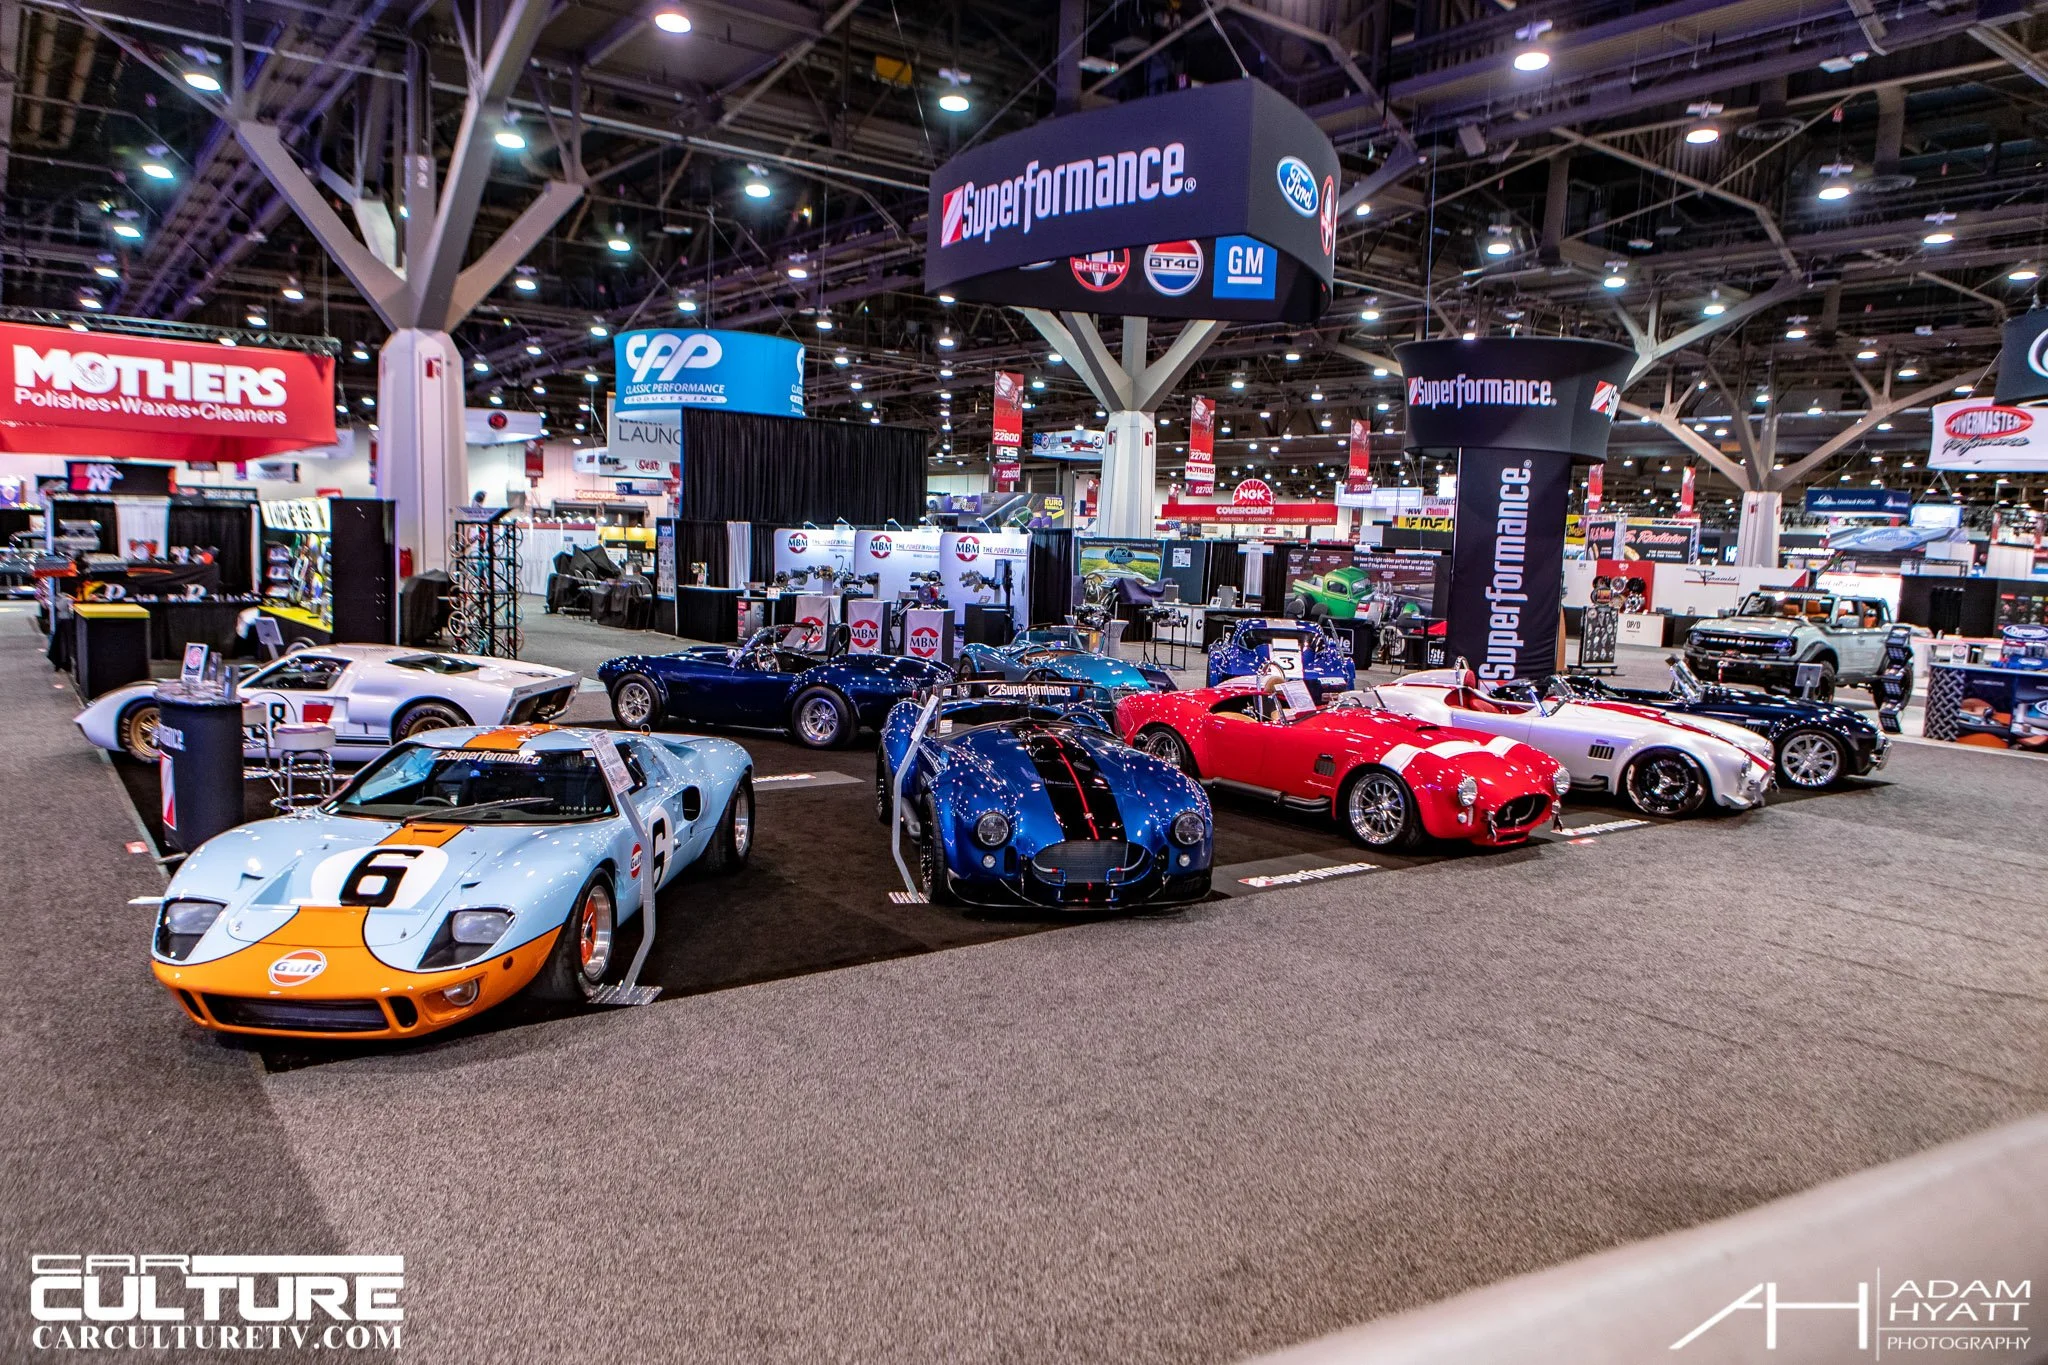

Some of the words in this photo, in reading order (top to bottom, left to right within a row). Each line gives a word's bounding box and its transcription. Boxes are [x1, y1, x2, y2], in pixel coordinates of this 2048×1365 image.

[1285, 163, 1314, 210] Ford
[1149, 257, 1200, 270] GT40
[1228, 245, 1264, 275] GM
[1074, 260, 1127, 274] SHELBY
[12, 344, 288, 408] MOTHERS
[625, 383, 652, 395] CLASSIC
[651, 383, 725, 394] PERFORMANCE
[1951, 410, 2021, 435] POWERMASTER
[994, 431, 1020, 443] 22600
[1190, 452, 1211, 462] 22700
[1186, 465, 1215, 475] MOTHERS
[1195, 486, 1213, 494] 22700
[1239, 489, 1266, 500] NGK
[1044, 498, 1063, 507] EURO
[1216, 506, 1273, 515] COVERCRAFT
[788, 538, 808, 548] MBM
[1637, 530, 1688, 544] Radiator
[870, 541, 892, 552] MBM
[956, 543, 980, 554] MBM
[852, 629, 879, 639] MBM
[910, 636, 938, 648] MBM
[1280, 656, 1295, 671] 3
[1001, 683, 1071, 698] Superformance
[446, 749, 542, 766] Superformance
[339, 850, 425, 908] 6
[274, 961, 322, 974] Gulf
